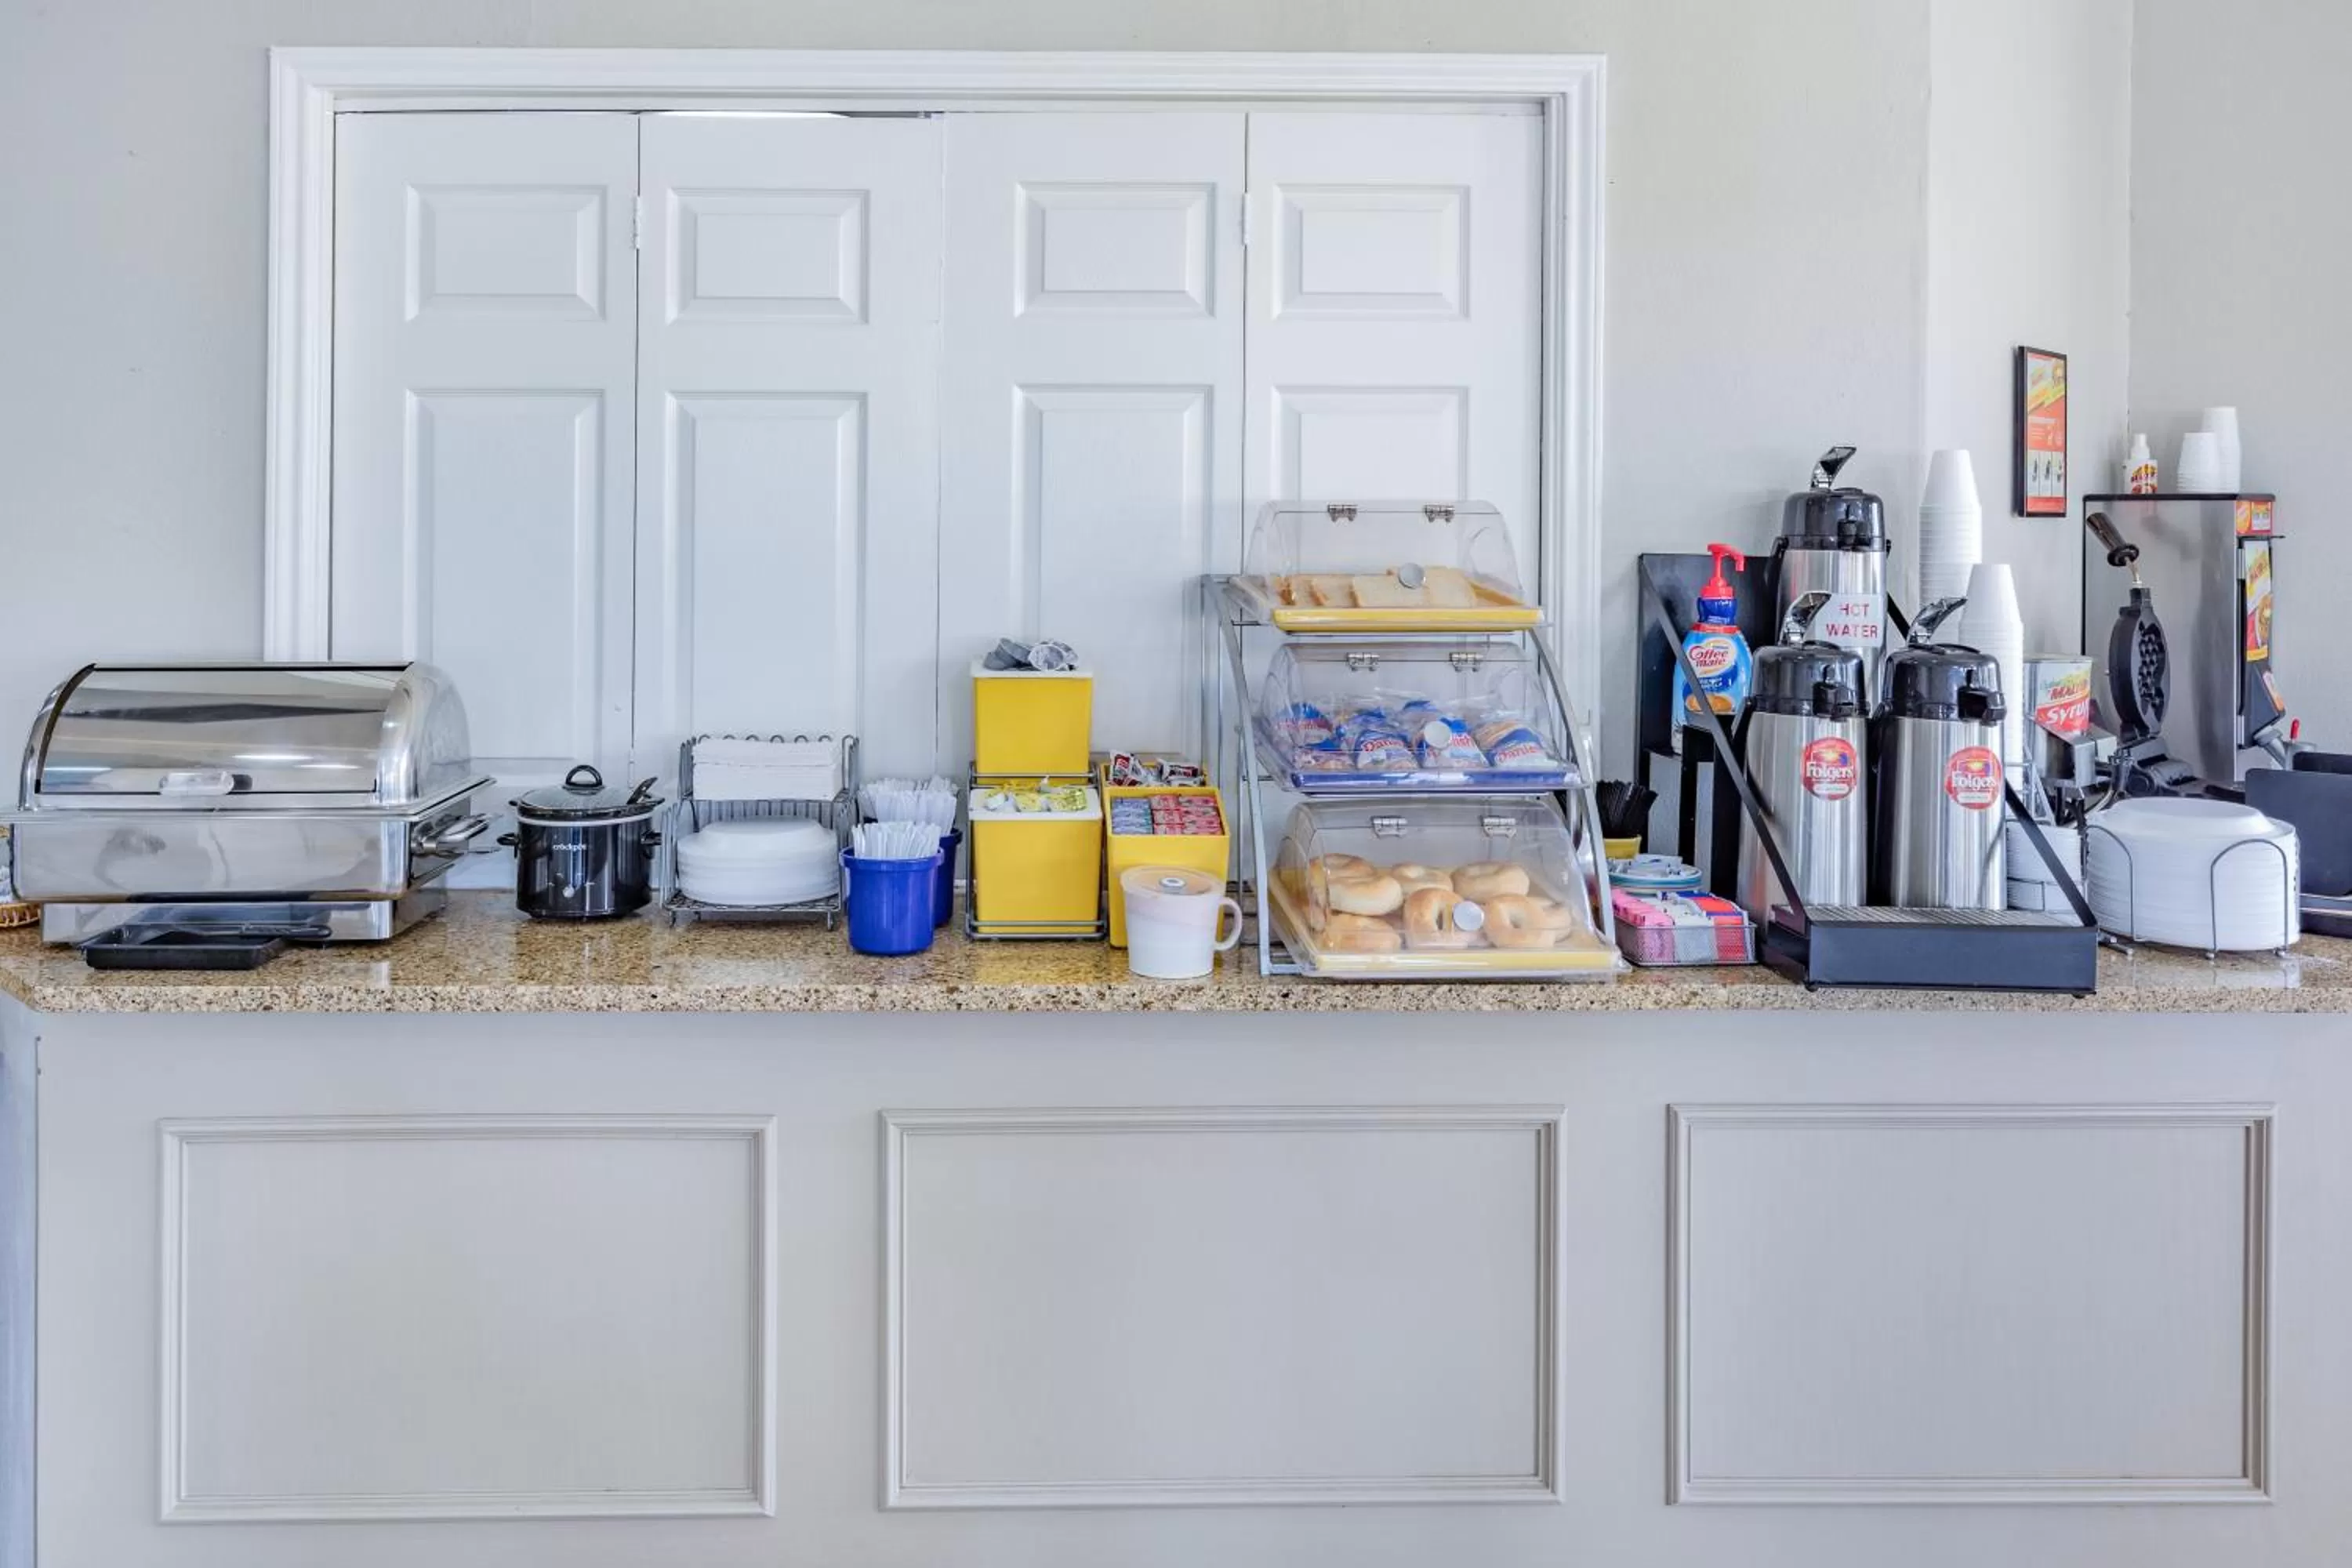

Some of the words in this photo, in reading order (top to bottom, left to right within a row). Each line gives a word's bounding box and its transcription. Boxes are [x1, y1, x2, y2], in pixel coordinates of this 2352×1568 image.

[1838, 602, 1870, 617] HOT
[1825, 623, 1878, 639] WATER
[1806, 761, 1855, 782] Folgers
